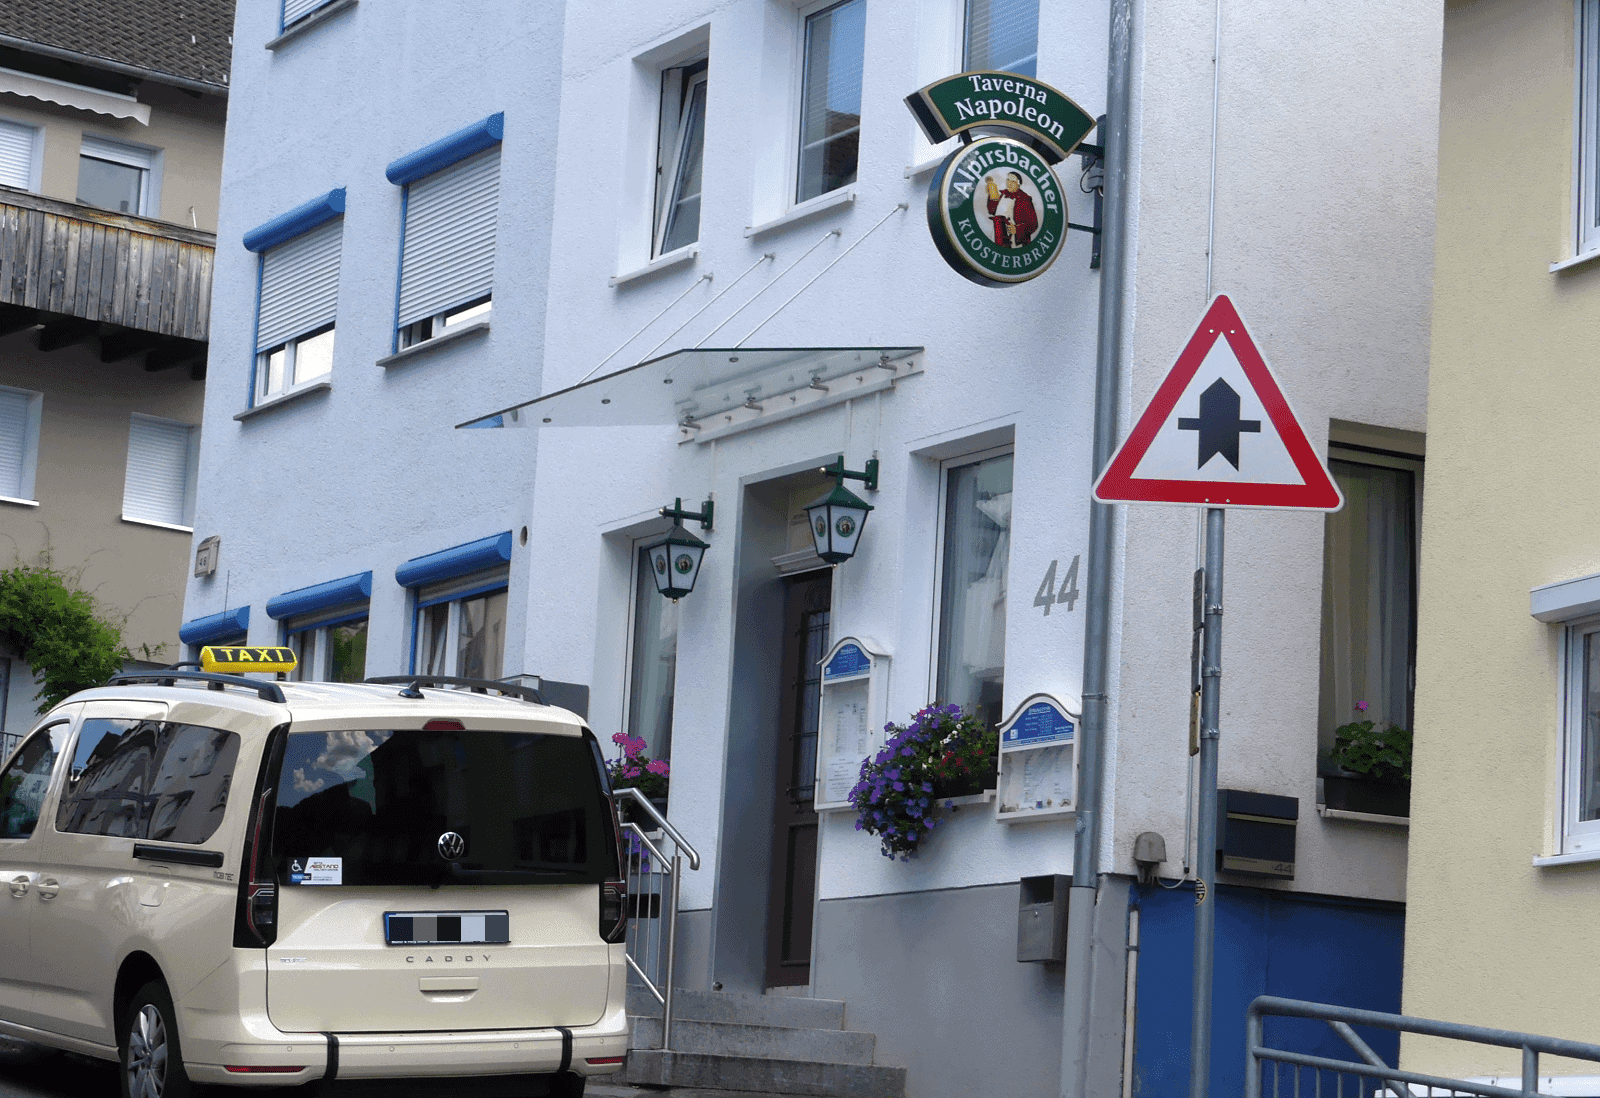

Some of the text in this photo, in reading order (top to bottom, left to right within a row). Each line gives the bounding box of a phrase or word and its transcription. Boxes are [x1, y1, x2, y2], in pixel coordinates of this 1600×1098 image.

[968, 74, 1047, 105] Taverna
[954, 97, 1065, 140] Napoleon
[953, 143, 1060, 215] Alpirsbacher
[958, 217, 1055, 269] KLOSTERBRÄU
[1033, 554, 1080, 617] 44
[220, 649, 284, 662] TAXI
[1273, 863, 1292, 874] 44
[406, 954, 492, 963] CADDY
